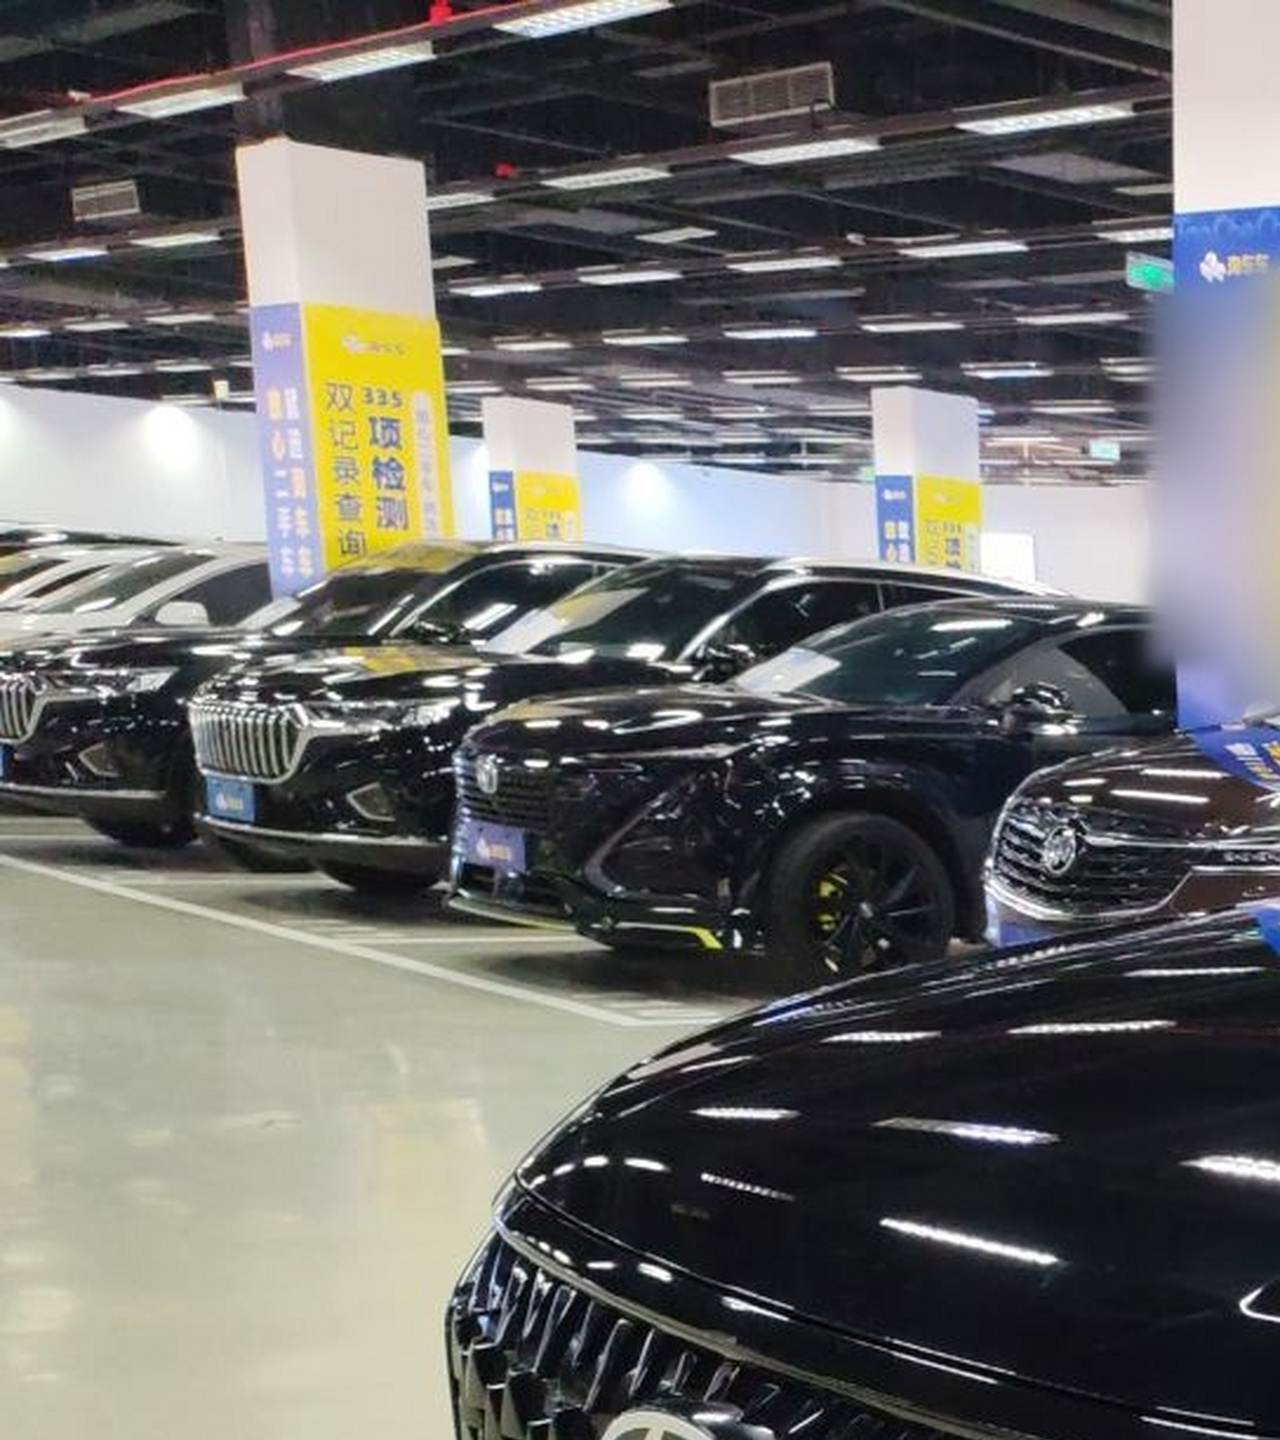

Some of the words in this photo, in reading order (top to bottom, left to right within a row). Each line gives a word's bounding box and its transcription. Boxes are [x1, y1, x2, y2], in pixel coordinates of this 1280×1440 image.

[362, 387, 403, 408] 335
[325, 382, 367, 557] 双记录查询
[368, 416, 409, 530] 项检测
